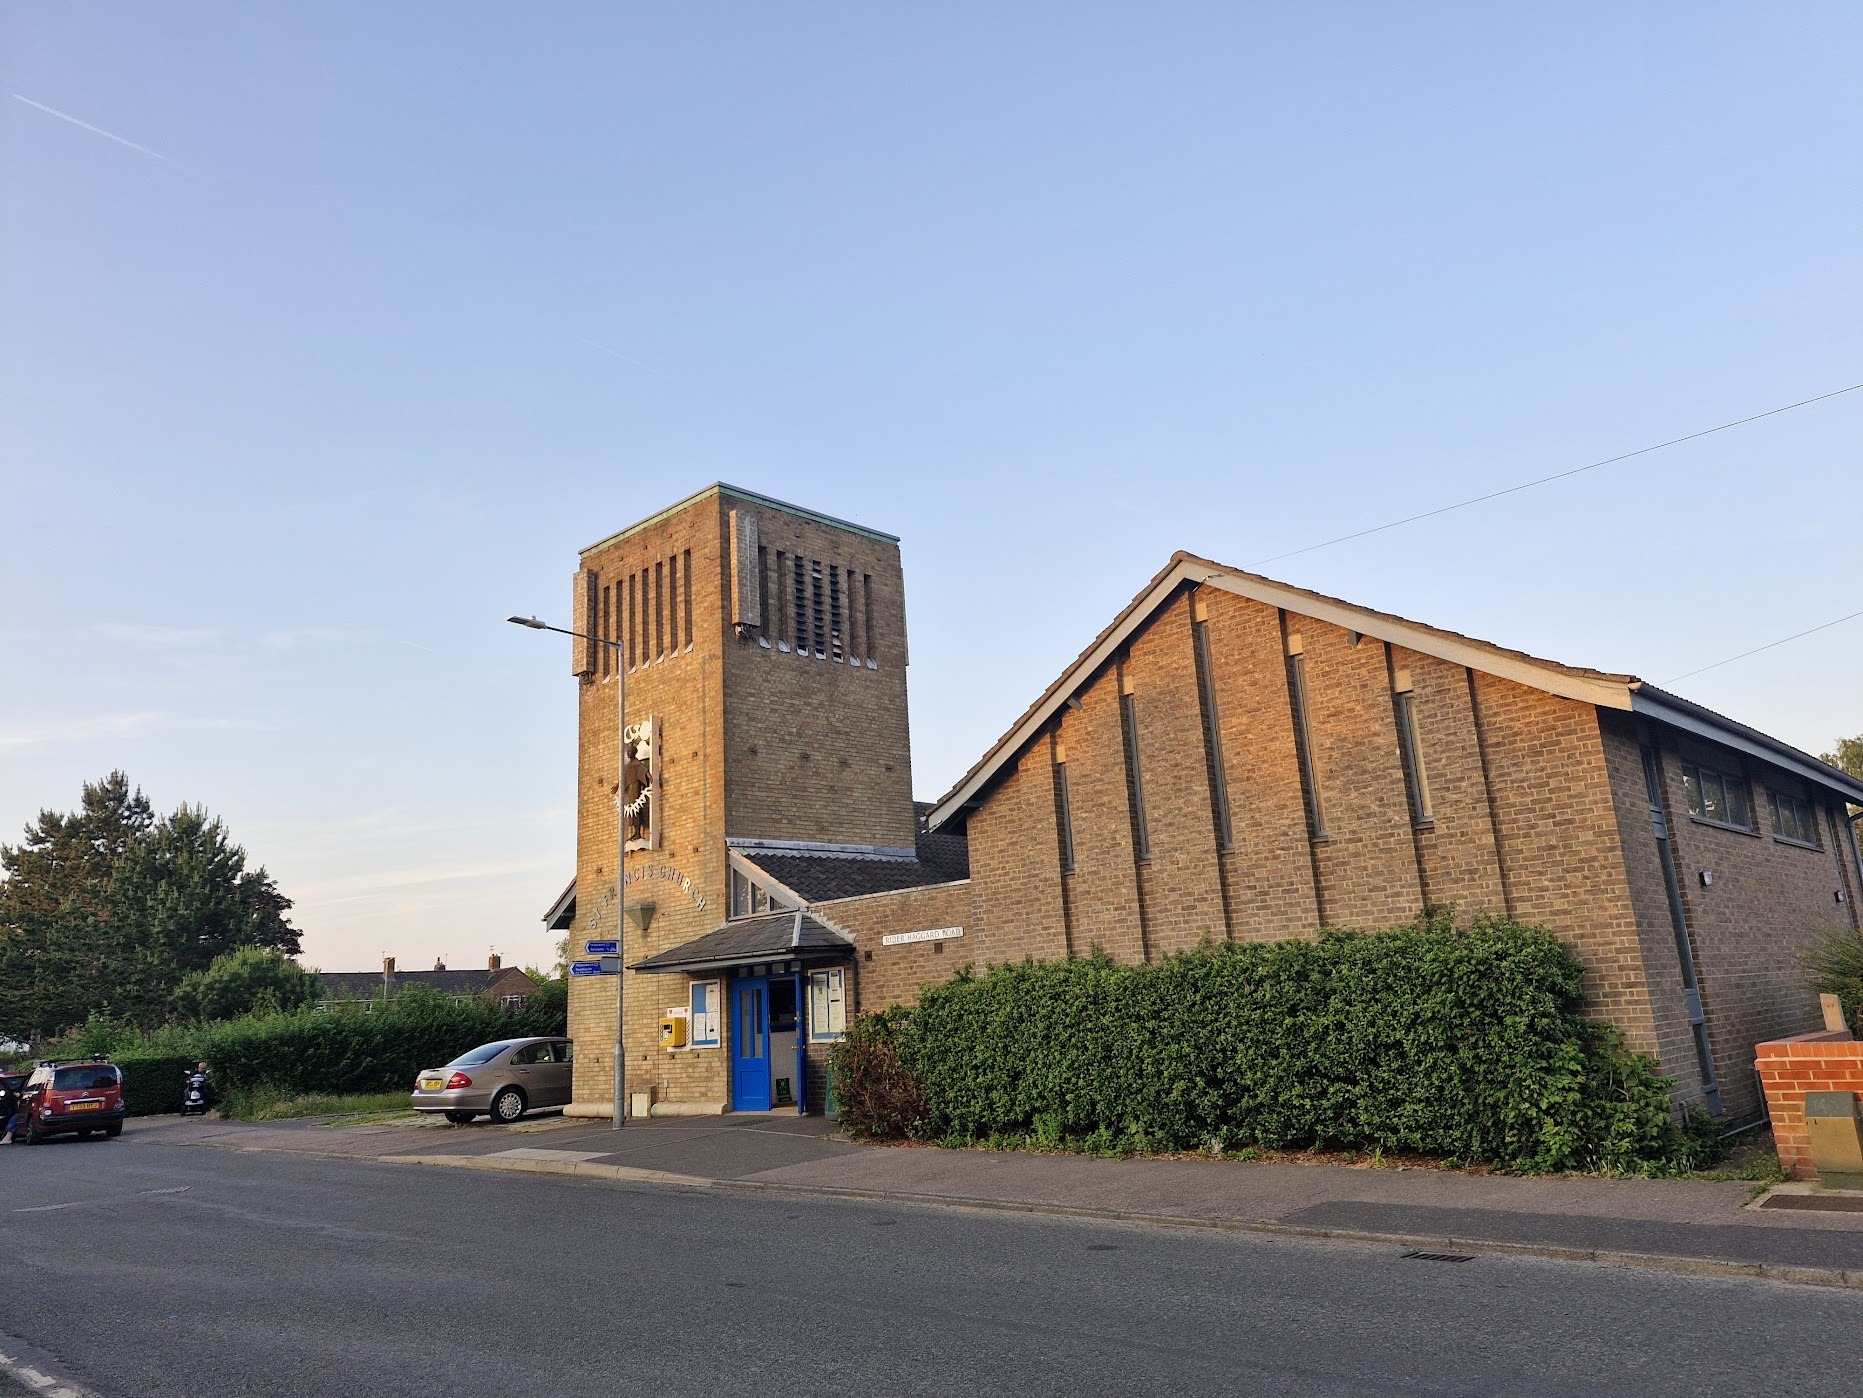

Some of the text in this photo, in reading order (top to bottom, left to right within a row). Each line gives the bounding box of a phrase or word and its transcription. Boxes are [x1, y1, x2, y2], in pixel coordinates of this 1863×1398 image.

[602, 864, 654, 907] FRNCIS
[659, 864, 707, 912] CHURCH
[885, 928, 961, 944] RIDER HAGGARD ROAD
